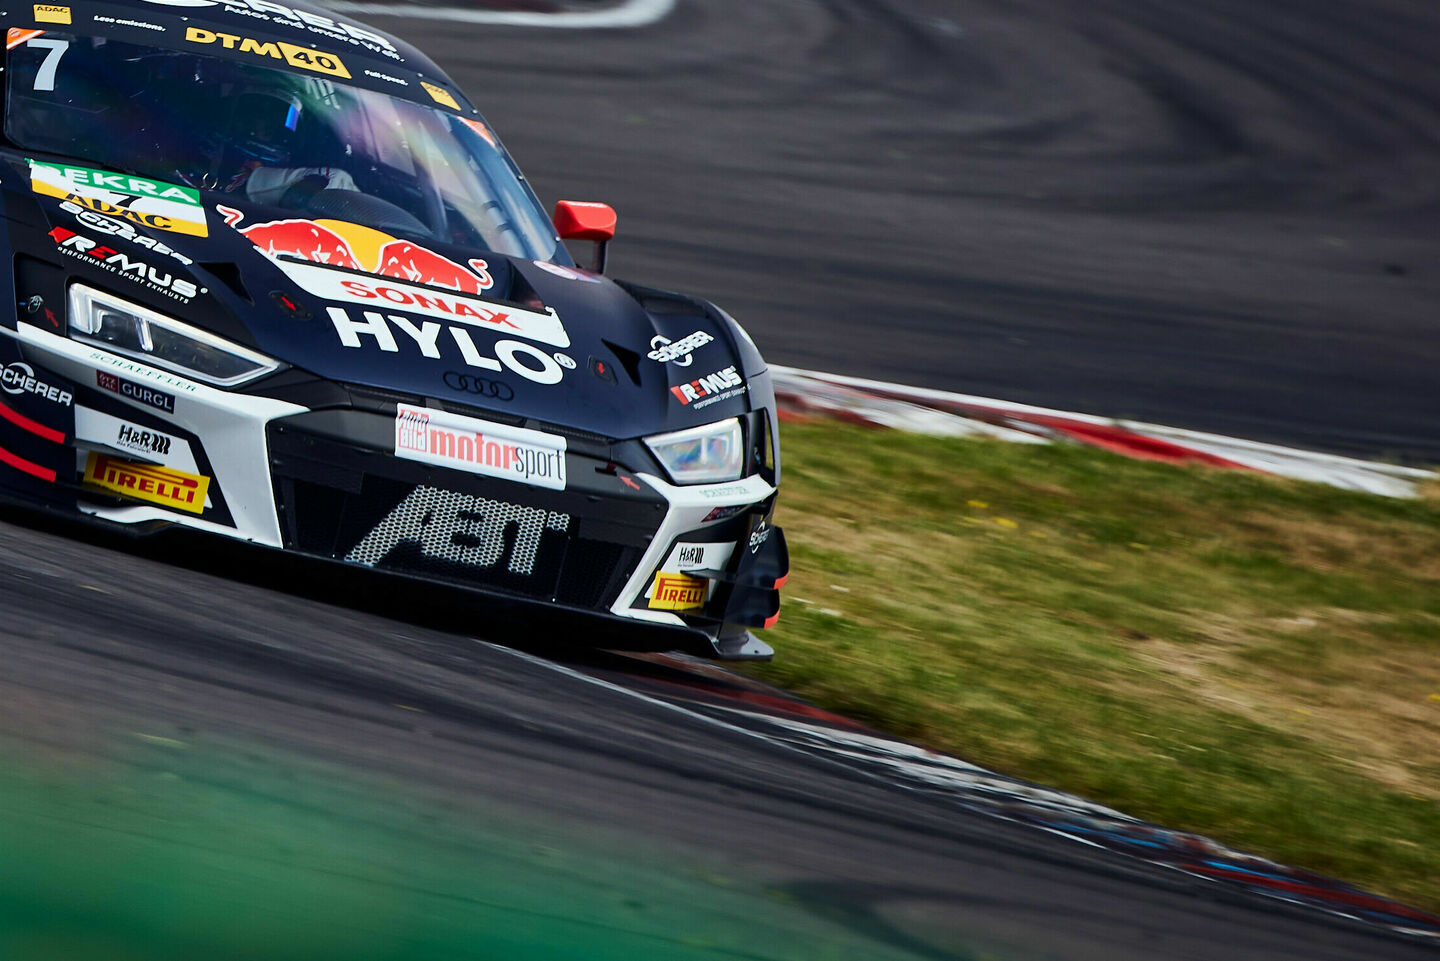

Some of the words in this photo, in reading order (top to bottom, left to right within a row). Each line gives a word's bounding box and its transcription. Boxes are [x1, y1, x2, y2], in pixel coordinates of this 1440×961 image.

[36, 5, 69, 15] ADAC
[26, 38, 70, 91] 7
[185, 25, 282, 61] DTM
[293, 50, 338, 71] 40
[58, 200, 194, 267] SCHERER
[65, 193, 172, 230] ADAC
[56, 246, 117, 273] PERFORMANCE
[117, 269, 146, 285] SPORT
[146, 280, 191, 305] EXHAUSTS
[340, 280, 523, 331] SONAX
[122, 382, 173, 410] GURGL
[93, 453, 199, 504] PIRELLI
[344, 483, 550, 577] ABT
[655, 577, 707, 604] PIRELLI
